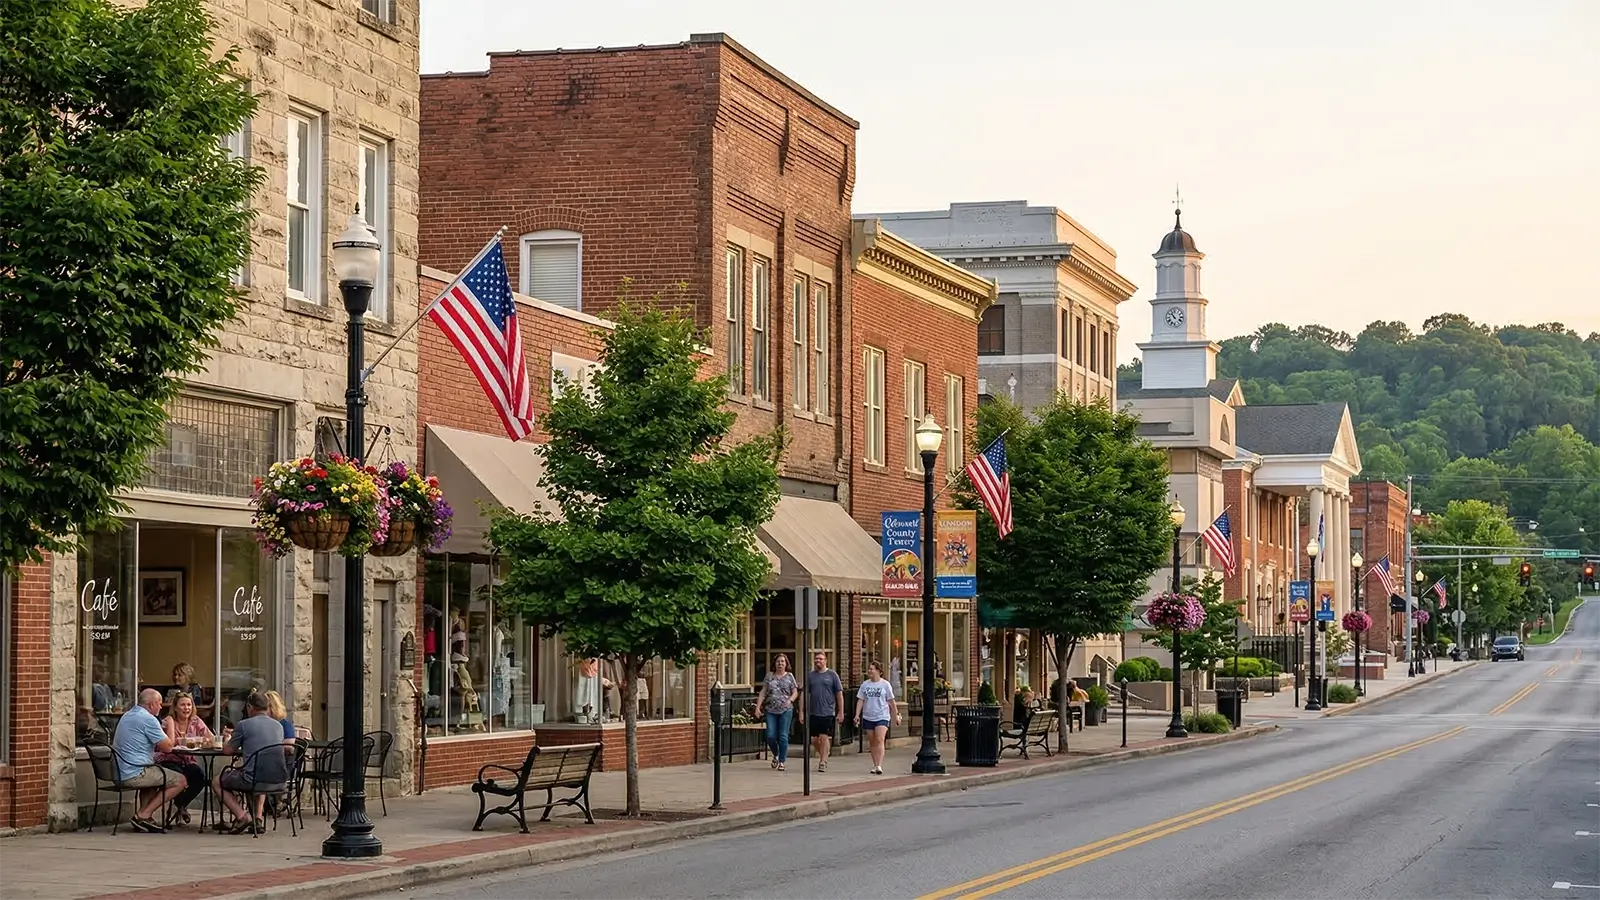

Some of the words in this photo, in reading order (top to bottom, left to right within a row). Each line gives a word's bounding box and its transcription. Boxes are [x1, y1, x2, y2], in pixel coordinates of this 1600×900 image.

[886, 528, 916, 539] County
[81, 577, 119, 621] Café
[233, 585, 264, 622] Café
